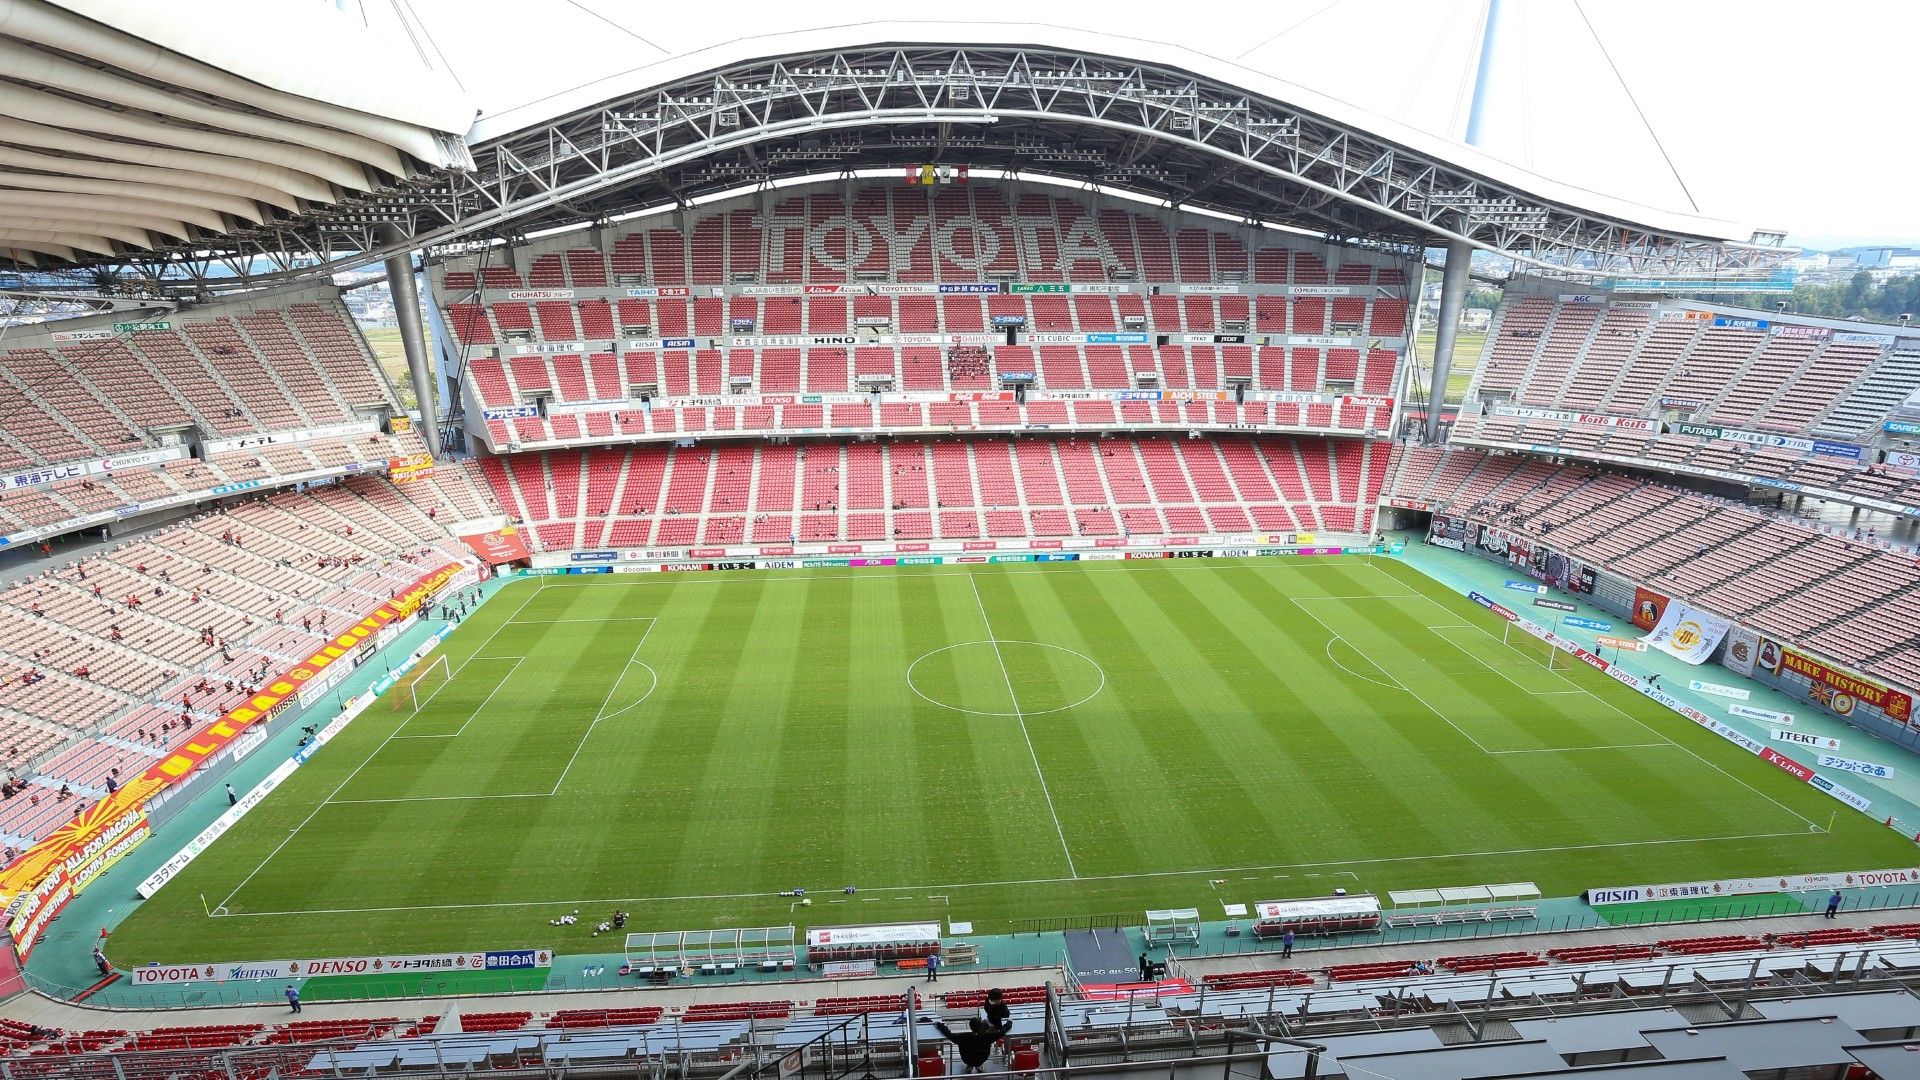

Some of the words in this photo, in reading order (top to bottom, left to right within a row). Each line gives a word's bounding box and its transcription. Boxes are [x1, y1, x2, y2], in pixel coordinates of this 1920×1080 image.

[752, 215, 1127, 272] TOYOTA
[511, 291, 552, 299] CHUHATSU
[1573, 295, 1591, 303] AGC
[1171, 391, 1194, 400] AICHI
[1196, 392, 1219, 400] STEEL
[486, 405, 535, 420] アサヒビール
[1681, 425, 1719, 437] FUTABA
[111, 457, 141, 467] CHUKYO
[14, 465, 81, 486] 東海テレビ
[646, 550, 679, 558] 朝日新聞
[1220, 549, 1249, 557] AiDEM
[764, 561, 795, 569] AiDEM
[1496, 607, 1517, 620] HINO
[1609, 666, 1638, 686] TOYOTA
[1784, 654, 1821, 678] MAKE
[1825, 671, 1885, 703] HISTORY
[1650, 689, 1675, 707] KINTO
[1678, 705, 1708, 725] JR東海
[157, 680, 296, 777] ULTRAS
[325, 715, 350, 737] TOYOTA
[1779, 731, 1819, 745] JTEKT
[1780, 760, 1805, 778] LINE
[66, 854, 84, 872] ALL
[84, 839, 104, 857] FOR
[102, 808, 142, 846] NAGOYA
[106, 827, 146, 862] FOREVER
[147, 853, 190, 891] トヨタホーム
[1858, 871, 1908, 885] TOYOTA
[1594, 888, 1639, 903] AISIN
[1669, 885, 1710, 897] 東海理化
[307, 959, 368, 975] DENSO
[403, 958, 453, 969] トヨタ紡織
[486, 952, 535, 967] 豊田合成
[136, 967, 199, 982] TOYOTA
[228, 963, 279, 981] MEITETSU
